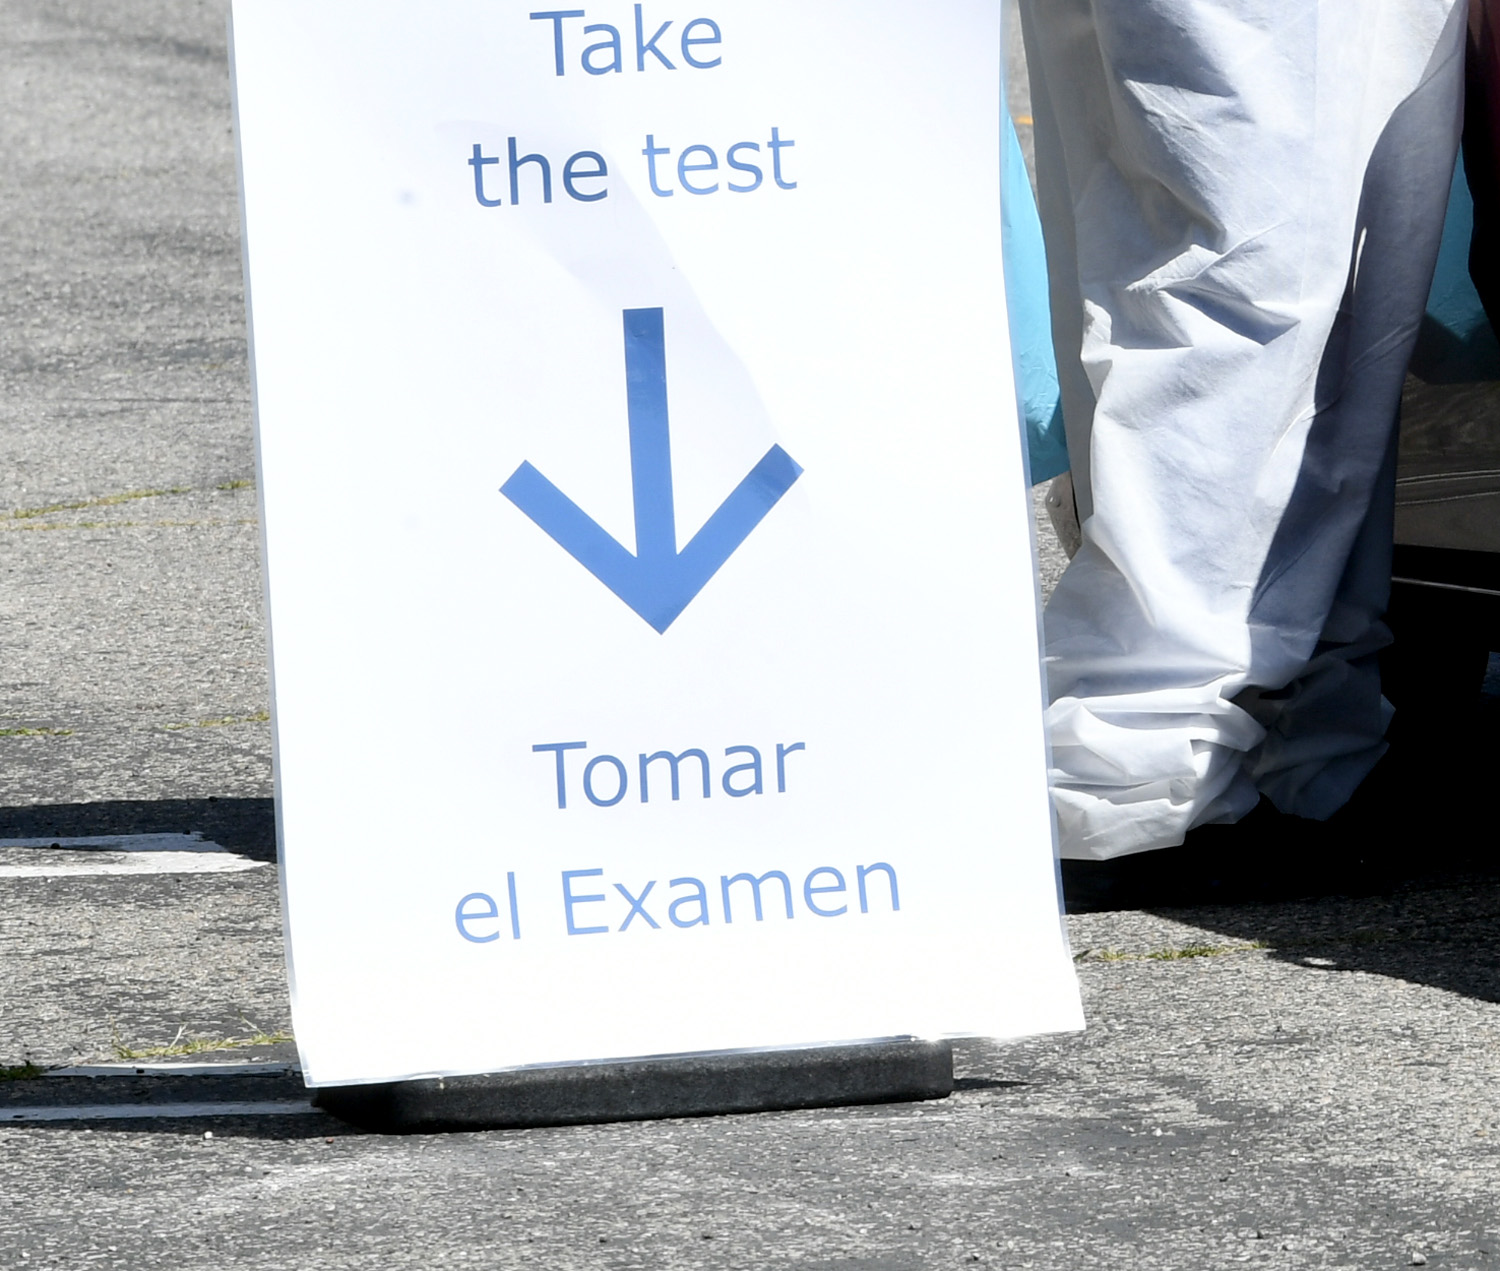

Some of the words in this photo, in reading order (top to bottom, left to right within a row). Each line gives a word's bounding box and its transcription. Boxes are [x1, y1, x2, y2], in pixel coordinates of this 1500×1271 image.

[530, 4, 722, 77] Take
[469, 136, 609, 207] the
[643, 127, 798, 198] test
[532, 740, 806, 810] Tomar
[455, 871, 521, 944] el
[561, 862, 900, 936] Examen
